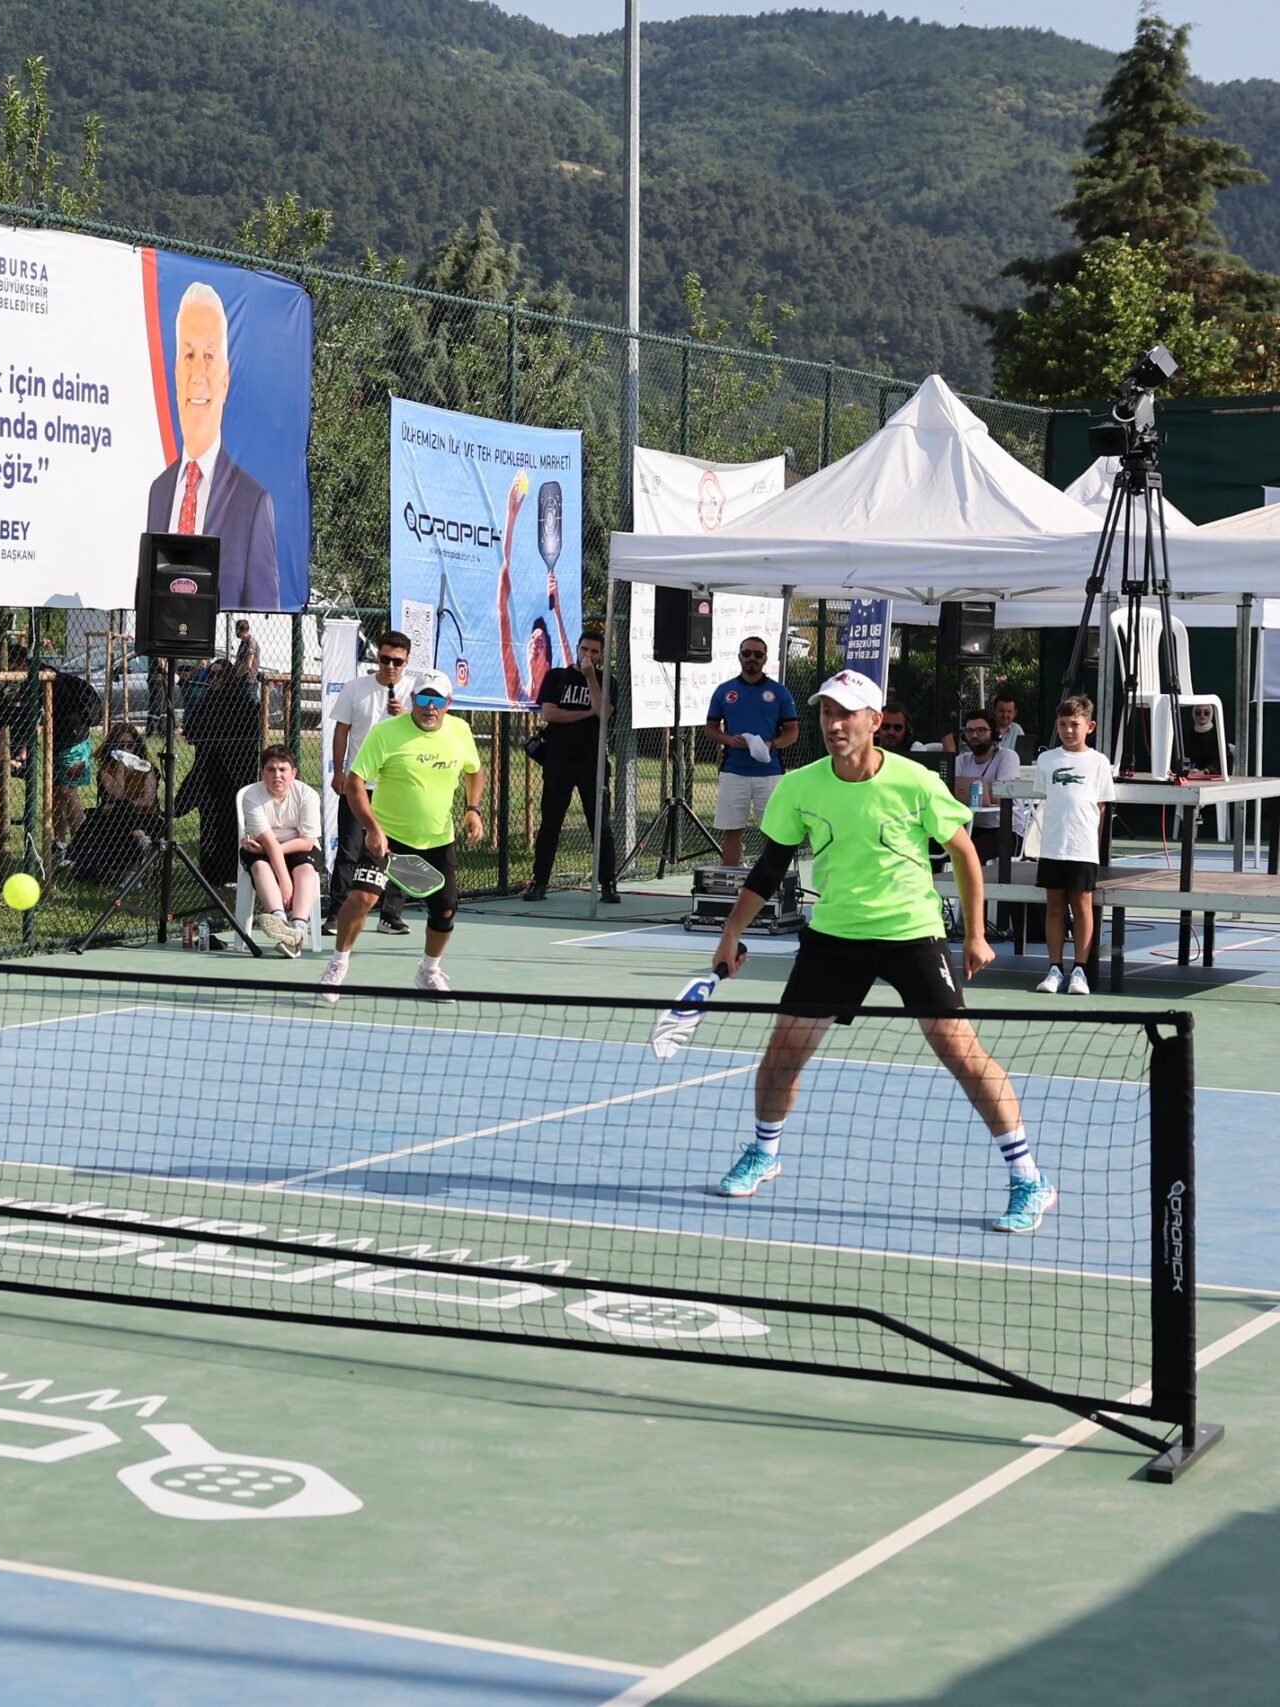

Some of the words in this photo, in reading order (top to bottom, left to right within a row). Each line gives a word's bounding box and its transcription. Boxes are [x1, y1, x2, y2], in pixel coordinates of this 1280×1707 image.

[9, 365, 46, 403] için
[52, 372, 110, 405] daima
[44, 416, 112, 453] olmaya
[464, 441, 475, 459] VE
[477, 445, 492, 462] TEK
[494, 448, 537, 469] PICKLEBALL
[539, 452, 571, 471] MARKETİ
[418, 513, 503, 548] DROPICK
[1, 548, 36, 563] BAŞKANI
[1170, 1196, 1183, 1293] DROPICK
